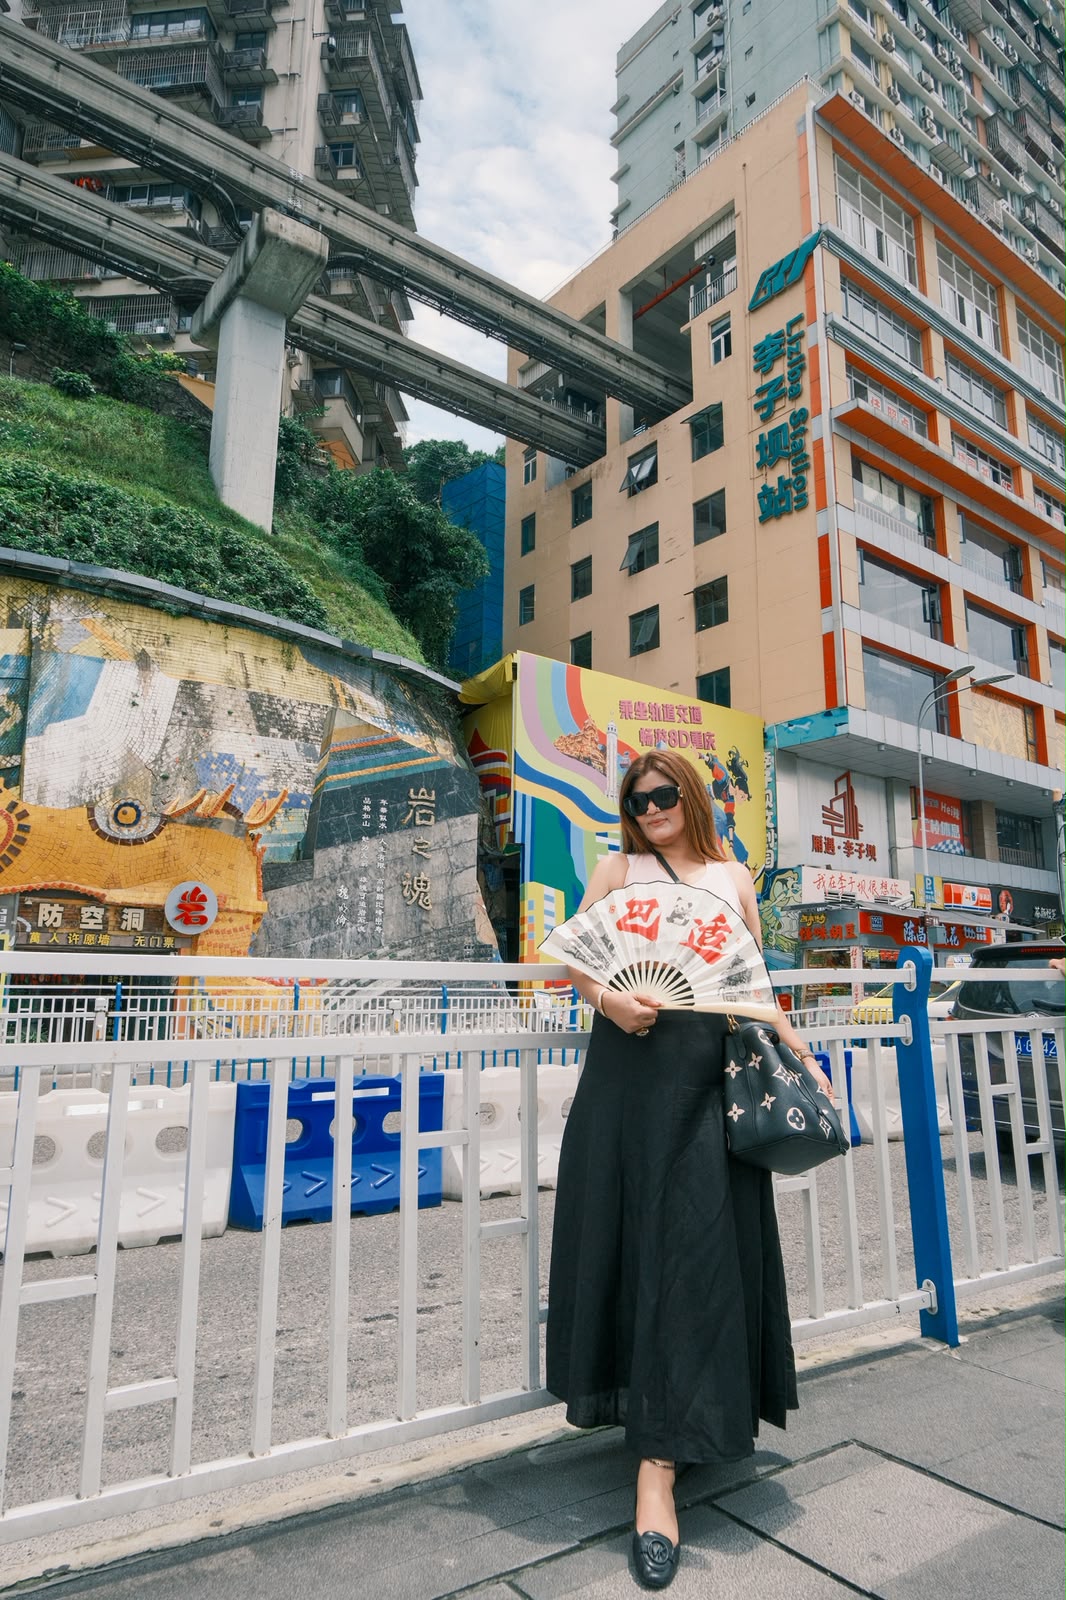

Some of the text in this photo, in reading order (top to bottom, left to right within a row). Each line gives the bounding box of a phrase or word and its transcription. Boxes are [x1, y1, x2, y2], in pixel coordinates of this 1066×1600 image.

[753, 328, 793, 523] 李子坝站
[786, 312, 810, 512] Liziba Station
[618, 700, 703, 725] 乘坐轨道交通
[638, 727, 717, 751] 畅游8D重庆
[813, 872, 902, 899] 我在李子坝很想你
[37, 903, 146, 931] 防空洞
[134, 935, 176, 948] 无门票
